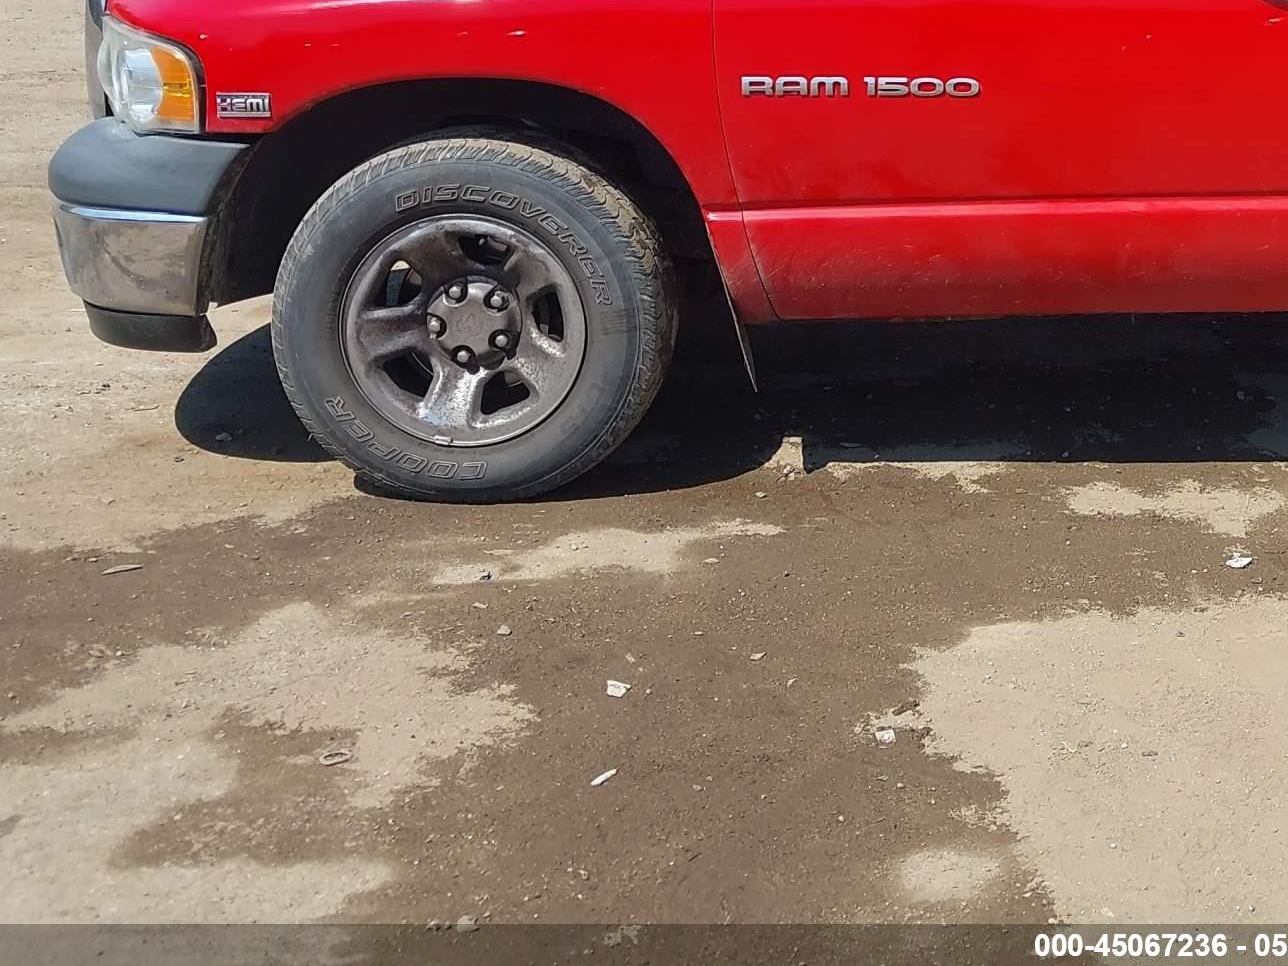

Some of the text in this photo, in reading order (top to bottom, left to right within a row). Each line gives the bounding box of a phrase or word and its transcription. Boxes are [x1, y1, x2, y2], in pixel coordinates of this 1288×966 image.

[216, 96, 271, 114] HEMI
[740, 75, 981, 98] RAM 1500
[394, 184, 614, 307] DISCOVERER
[324, 396, 489, 481] COOPER
